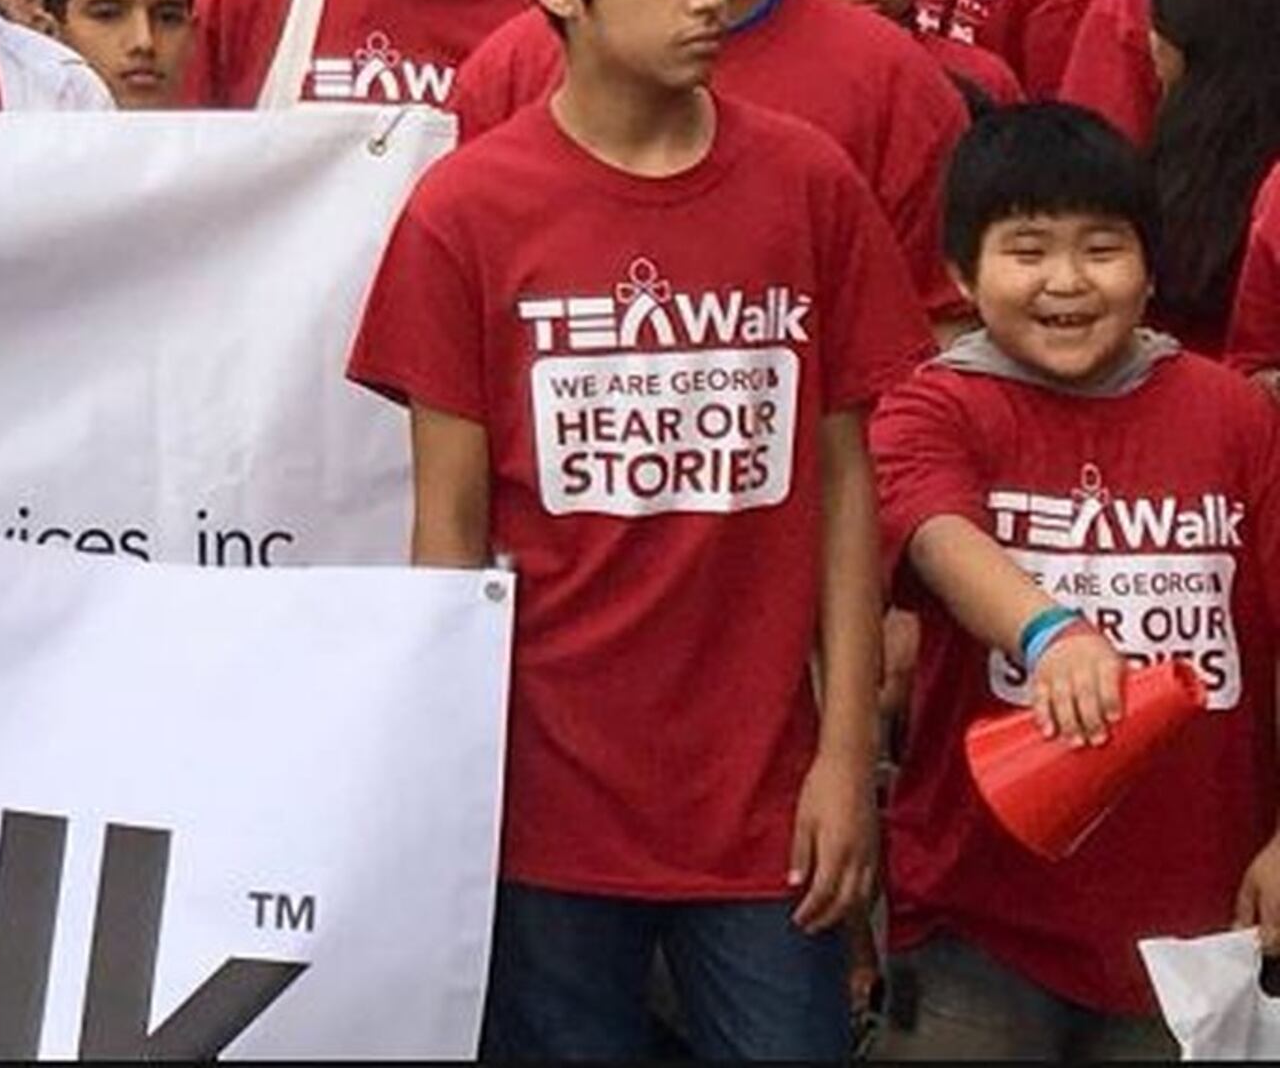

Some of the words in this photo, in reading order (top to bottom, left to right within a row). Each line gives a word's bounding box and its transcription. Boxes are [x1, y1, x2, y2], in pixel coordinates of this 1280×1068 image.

[550, 374, 599, 399] WE
[606, 371, 662, 396] ARE
[555, 407, 684, 446] HEAR
[696, 400, 777, 440] OUR
[561, 445, 770, 497] STORIES
[1053, 572, 1101, 597] ARE
[1141, 606, 1227, 643] OUR
